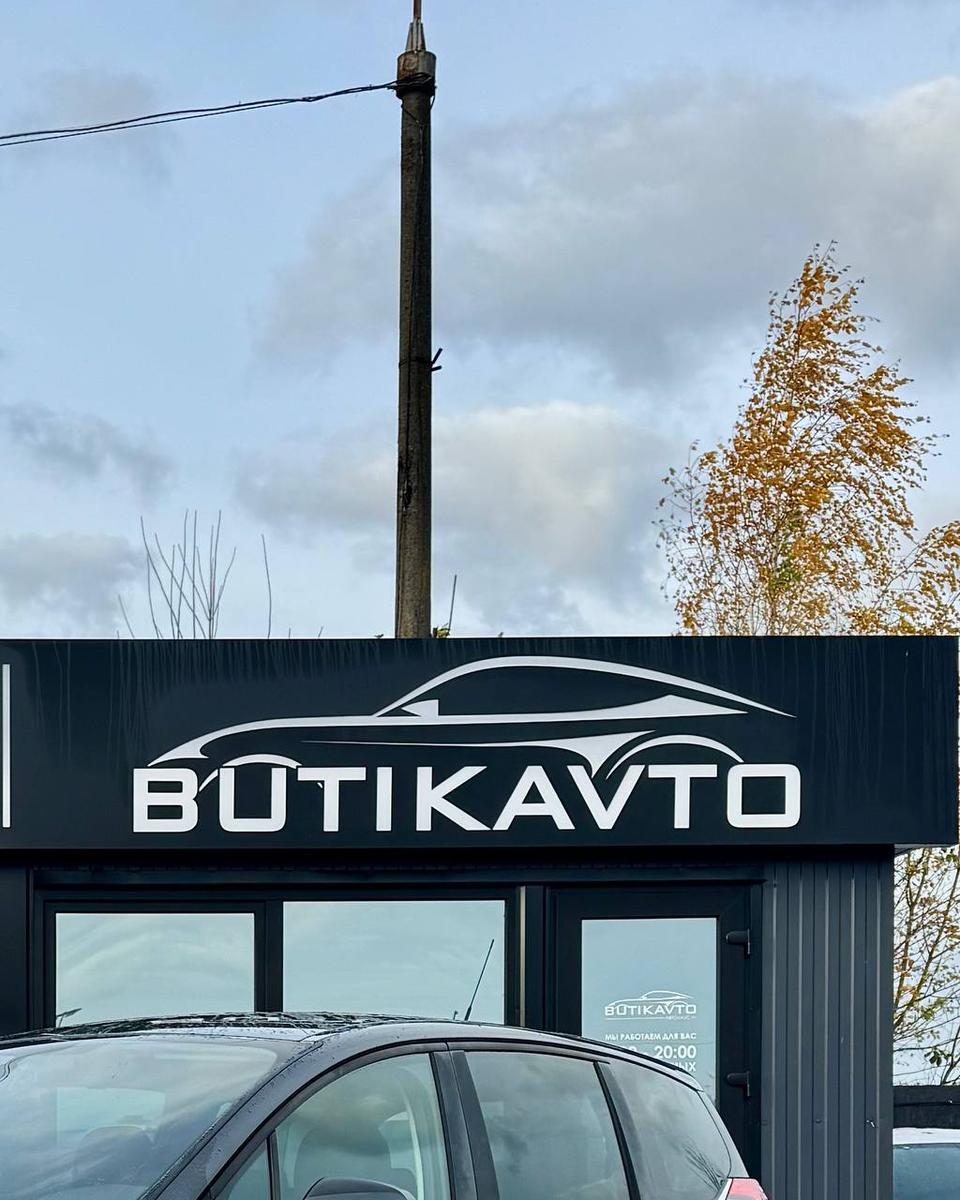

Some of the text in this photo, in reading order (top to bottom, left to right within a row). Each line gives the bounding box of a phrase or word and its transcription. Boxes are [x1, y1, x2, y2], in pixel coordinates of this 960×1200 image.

[132, 763, 803, 833] BUTIKAVTO
[604, 1004, 697, 1016] BUTIKAVTO
[605, 1032, 697, 1041] МЫ РАБОТАЕМ ДЛЯ ВАС
[654, 1045, 697, 1059] 20:00
